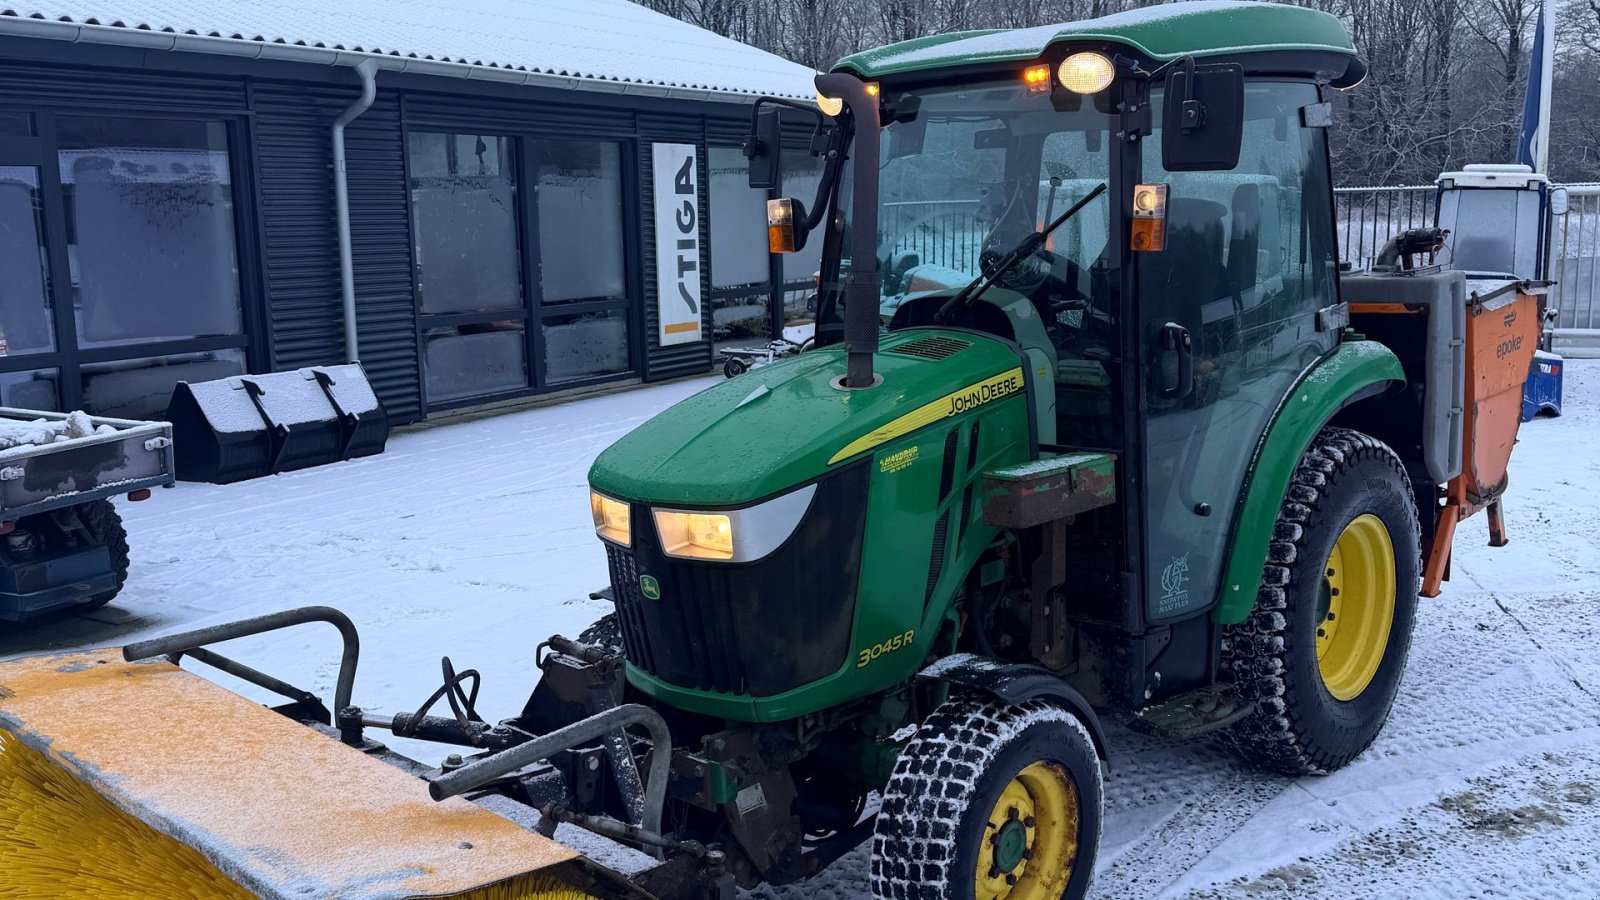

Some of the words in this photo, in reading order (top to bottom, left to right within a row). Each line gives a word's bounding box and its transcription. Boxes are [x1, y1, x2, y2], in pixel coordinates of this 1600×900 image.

[675, 156, 698, 314] STIGA
[1496, 334, 1522, 360] epoke
[948, 393, 981, 416] JOHN
[981, 376, 1018, 400] DEERE
[857, 629, 914, 668] 3045R
